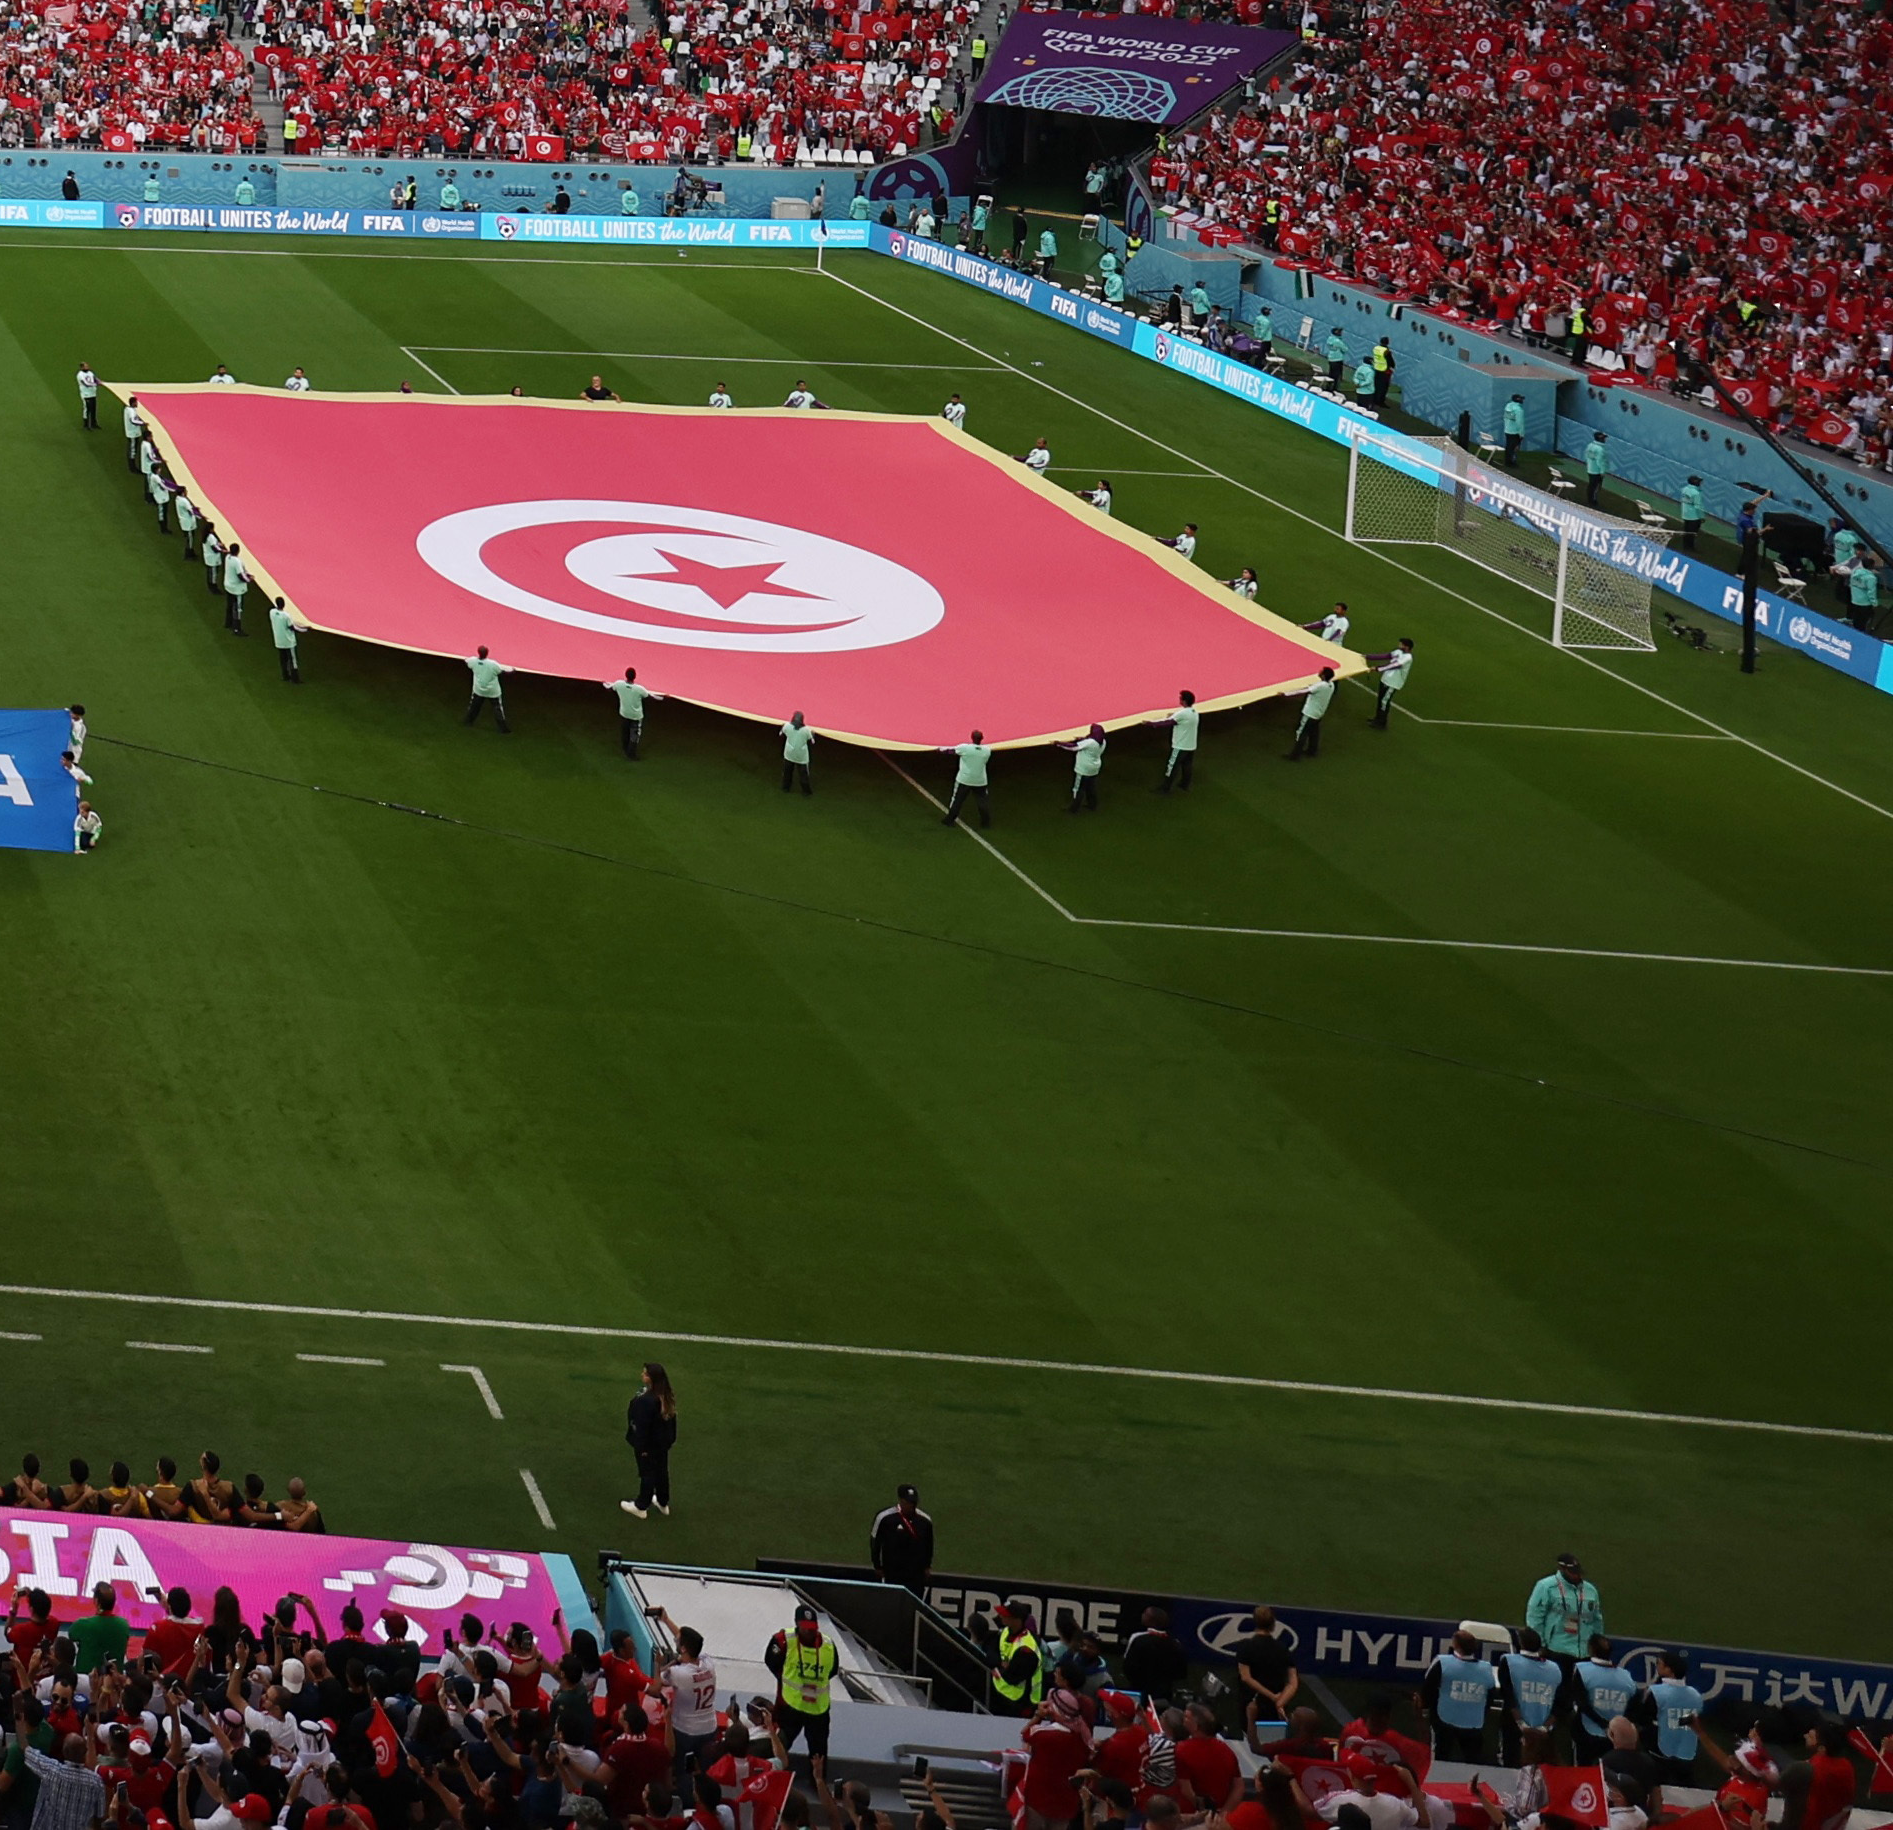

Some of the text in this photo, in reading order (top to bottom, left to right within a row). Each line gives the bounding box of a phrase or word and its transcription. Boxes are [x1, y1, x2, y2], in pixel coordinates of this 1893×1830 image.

[1042, 28, 1240, 57] FIFA WORLD CUP
[144, 208, 350, 233] FOOTBALL UNITES the World
[363, 215, 405, 232] FIFA
[525, 220, 735, 244] FOOTBALL UNITES the World
[750, 227, 792, 241] FIFA
[907, 238, 1033, 305] FOOTBALL UNITES the World
[1051, 295, 1077, 320] FIFA
[1172, 342, 1315, 427] FOOTBALL UNITES the World
[1566, 514, 1609, 557] UNITES
[1610, 533, 1635, 570] the
[1636, 541, 1689, 597] World
[693, 1684, 716, 1711] 12
[1700, 1662, 1825, 1708] 万达
